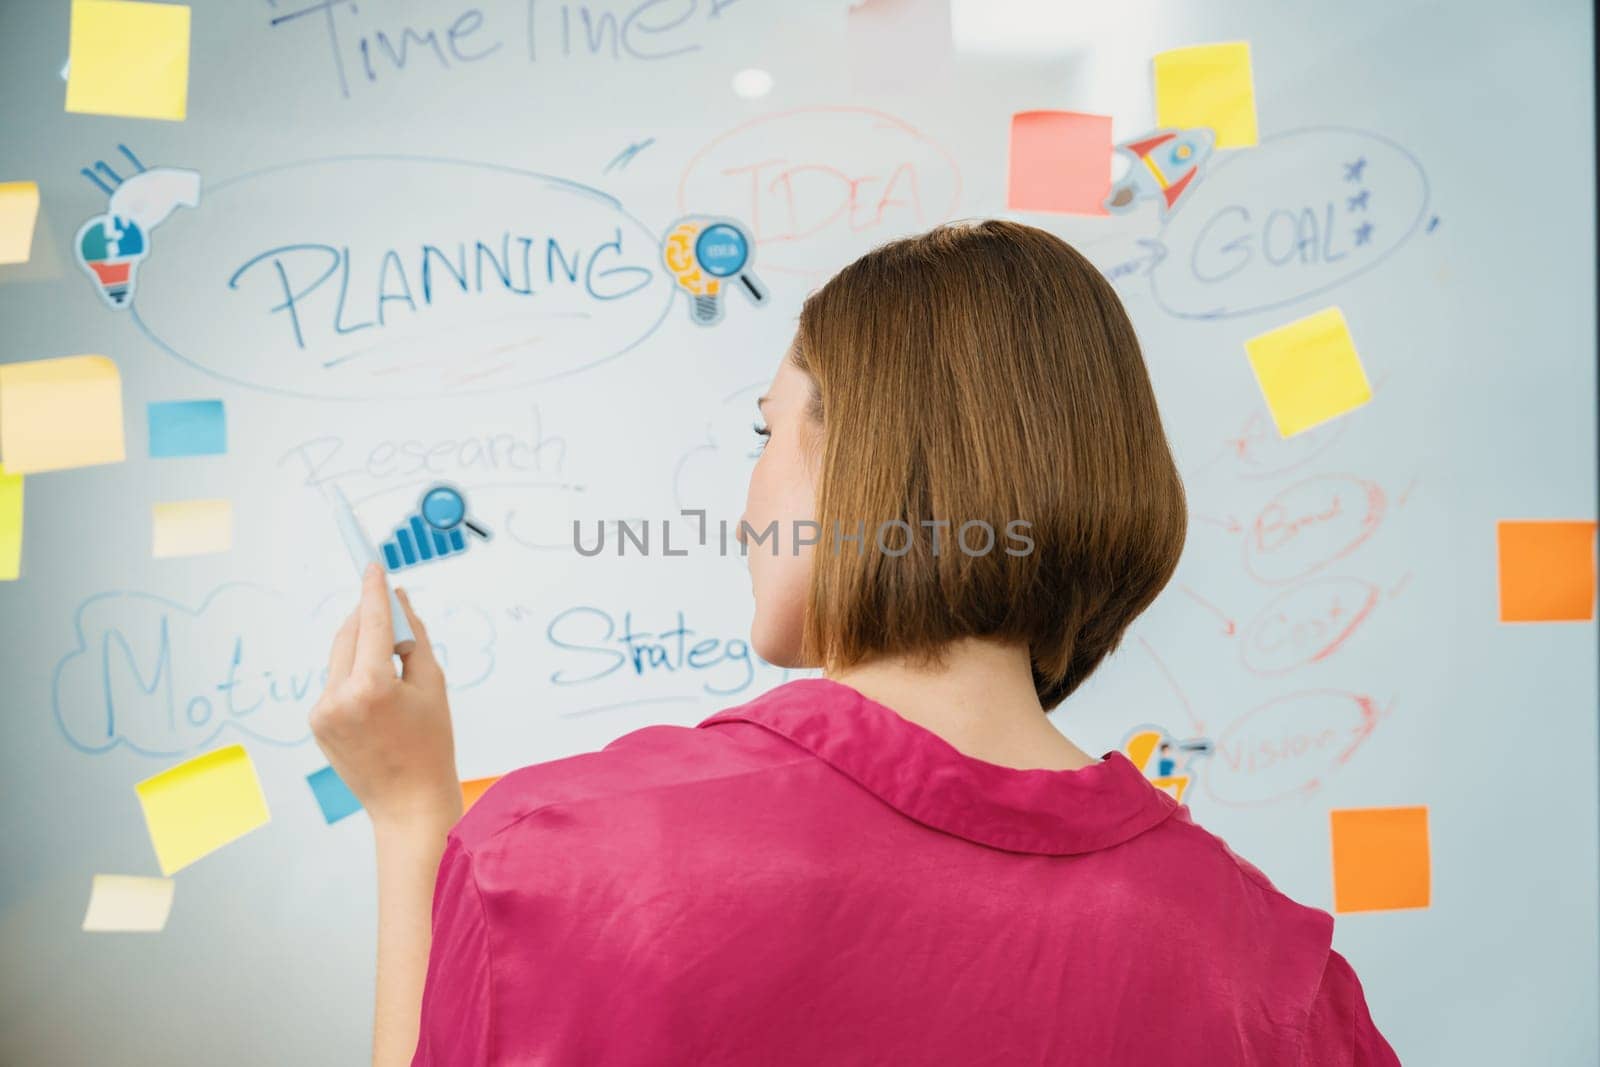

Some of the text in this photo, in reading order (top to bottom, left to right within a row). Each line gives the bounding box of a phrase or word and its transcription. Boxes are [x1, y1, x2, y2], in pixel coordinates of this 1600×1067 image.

[721, 159, 925, 246] IDEA
[1191, 203, 1346, 284] GOAL
[229, 229, 653, 349] PLANNING
[277, 403, 567, 486] Research
[547, 606, 790, 695] Strateg
